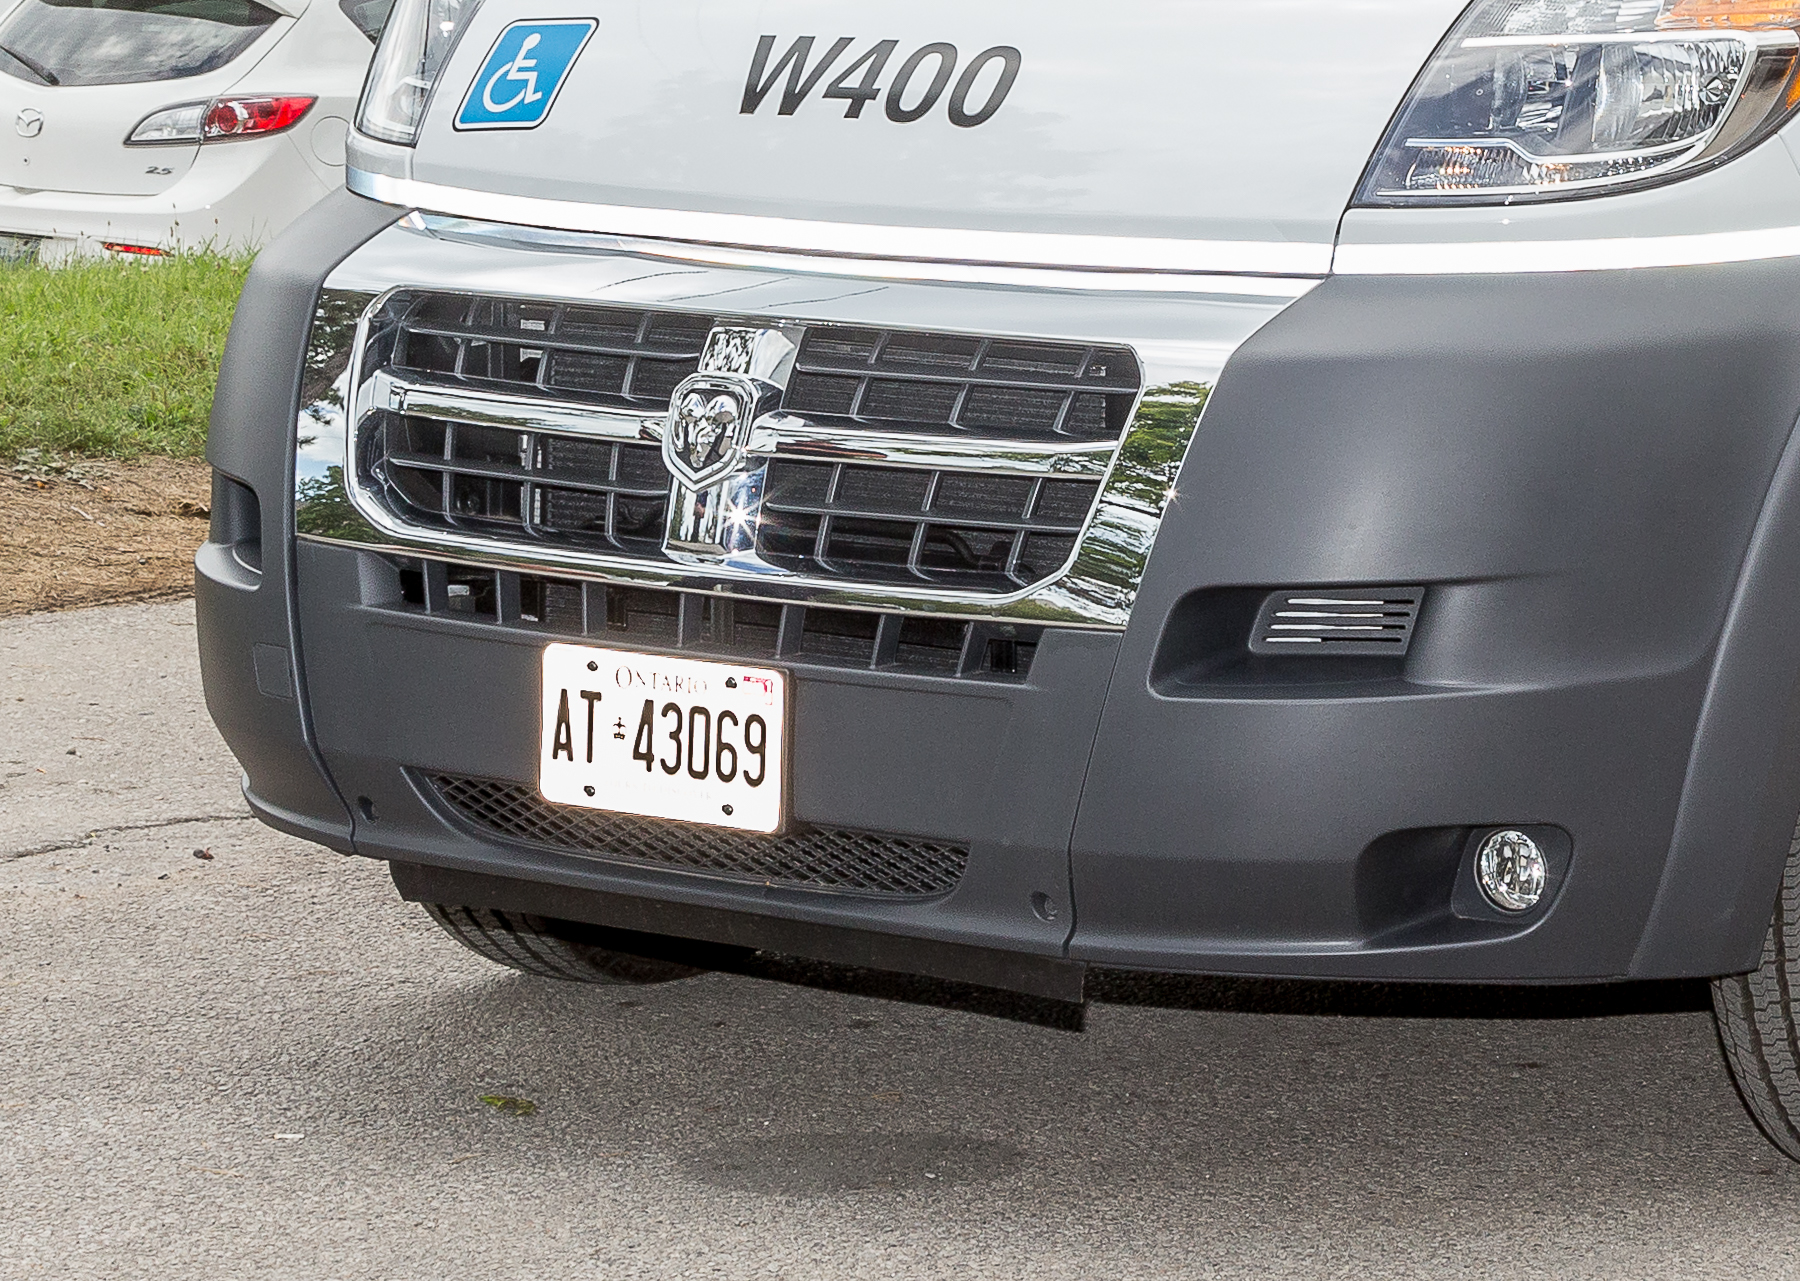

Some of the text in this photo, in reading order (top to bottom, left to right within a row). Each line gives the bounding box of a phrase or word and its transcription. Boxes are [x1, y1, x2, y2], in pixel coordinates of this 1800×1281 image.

[738, 33, 1022, 129] W400
[615, 665, 708, 696] ONTARIO
[552, 687, 767, 788] AT 43069
